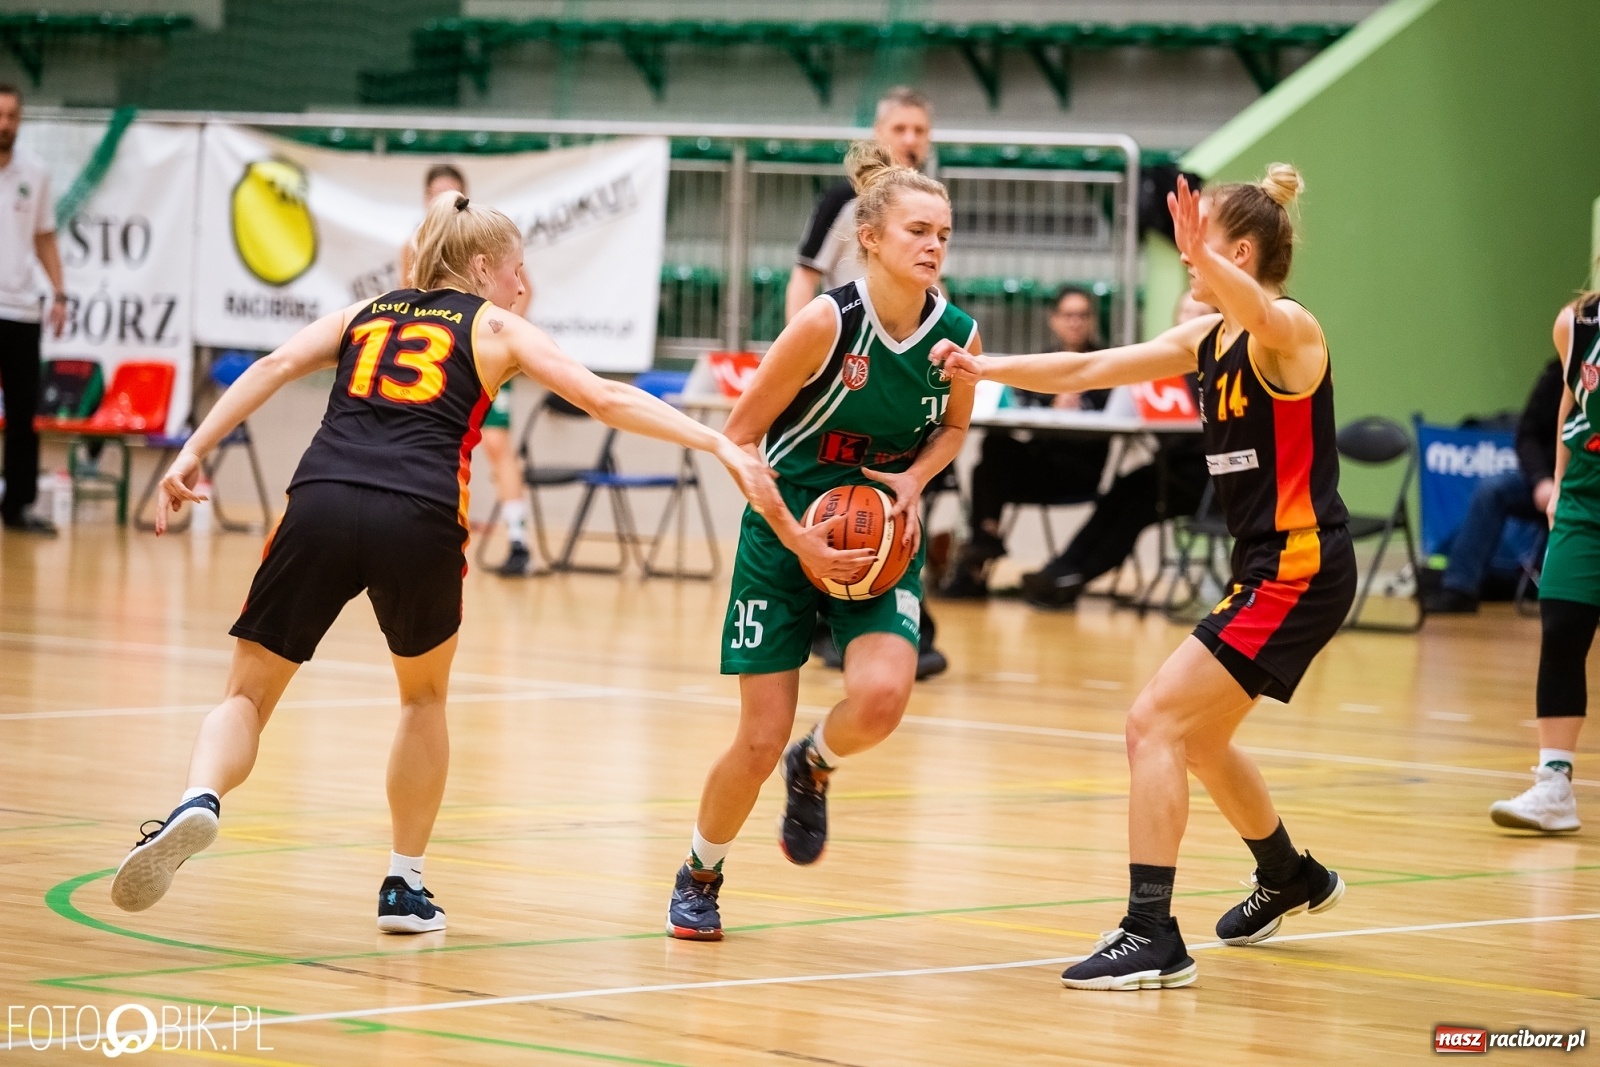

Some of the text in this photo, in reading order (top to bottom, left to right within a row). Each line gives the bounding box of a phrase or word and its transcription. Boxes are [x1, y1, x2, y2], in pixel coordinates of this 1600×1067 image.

[65, 211, 152, 270] STO
[348, 317, 455, 405] 13
[1216, 368, 1248, 421] 14
[1426, 441, 1519, 478] molte
[854, 510, 867, 535] FIBA
[731, 599, 768, 649] 35
